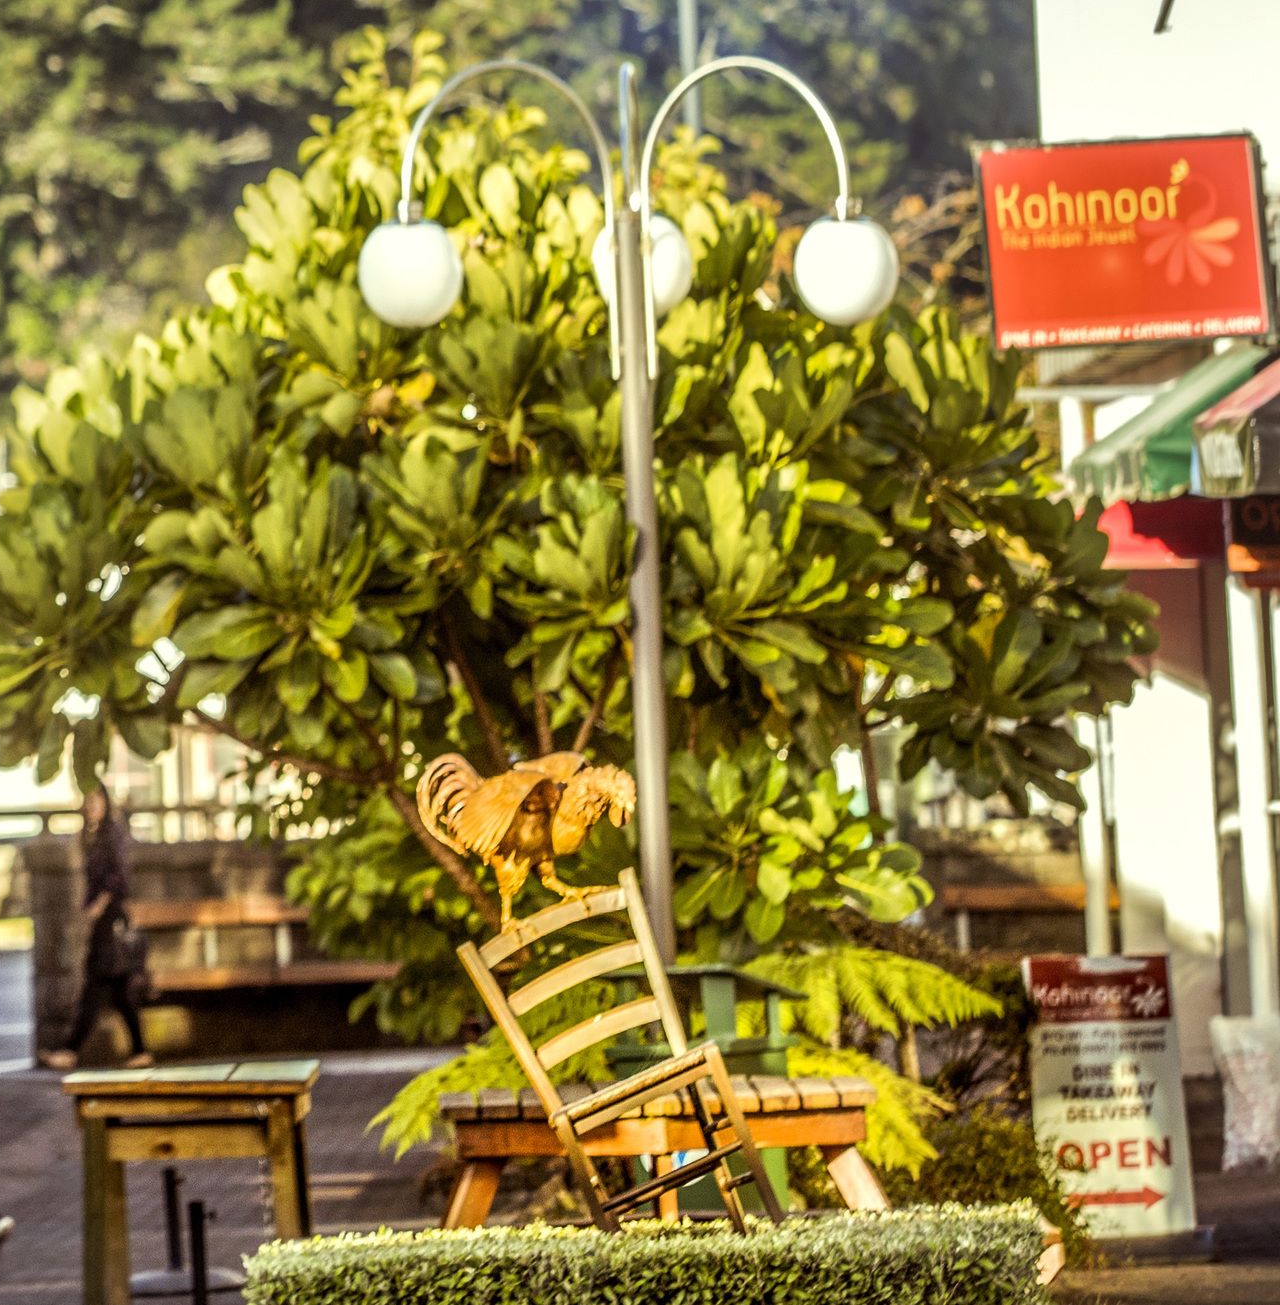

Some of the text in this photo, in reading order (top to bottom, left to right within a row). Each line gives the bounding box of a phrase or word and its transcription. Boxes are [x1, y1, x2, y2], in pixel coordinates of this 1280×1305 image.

[994, 179, 1181, 231] Kohinoor
[1058, 1080, 1157, 1100] TAKEAWAY
[1066, 1102, 1153, 1123] DELIVERY
[1056, 1135, 1172, 1171] OPEN
